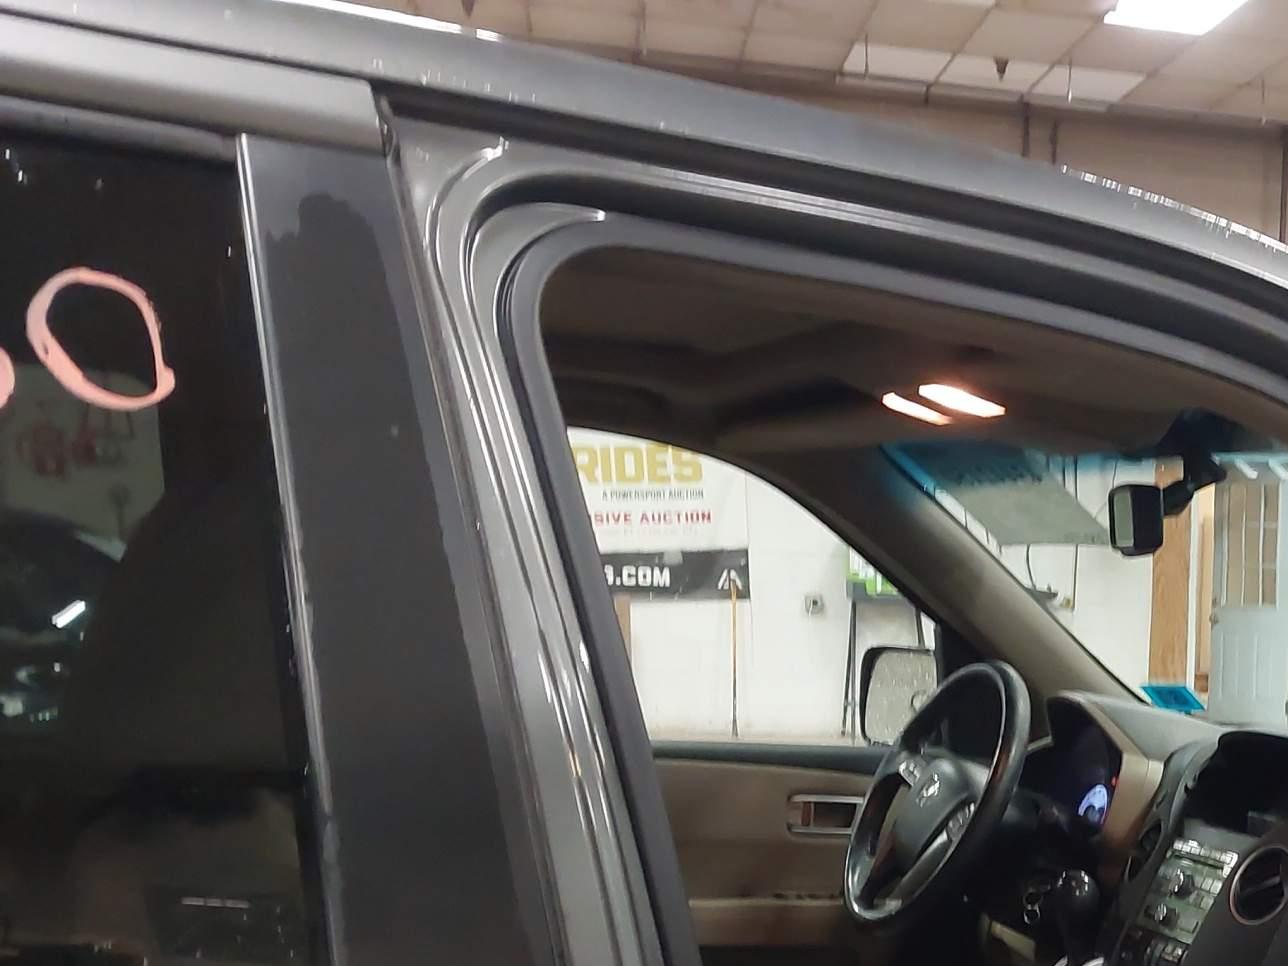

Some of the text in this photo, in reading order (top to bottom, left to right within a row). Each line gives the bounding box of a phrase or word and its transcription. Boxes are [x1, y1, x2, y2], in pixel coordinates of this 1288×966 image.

[572, 443, 704, 484] RIDES
[610, 488, 667, 501] POWERSPORT
[668, 487, 705, 500] AUCTION
[640, 509, 712, 525] AUCTION
